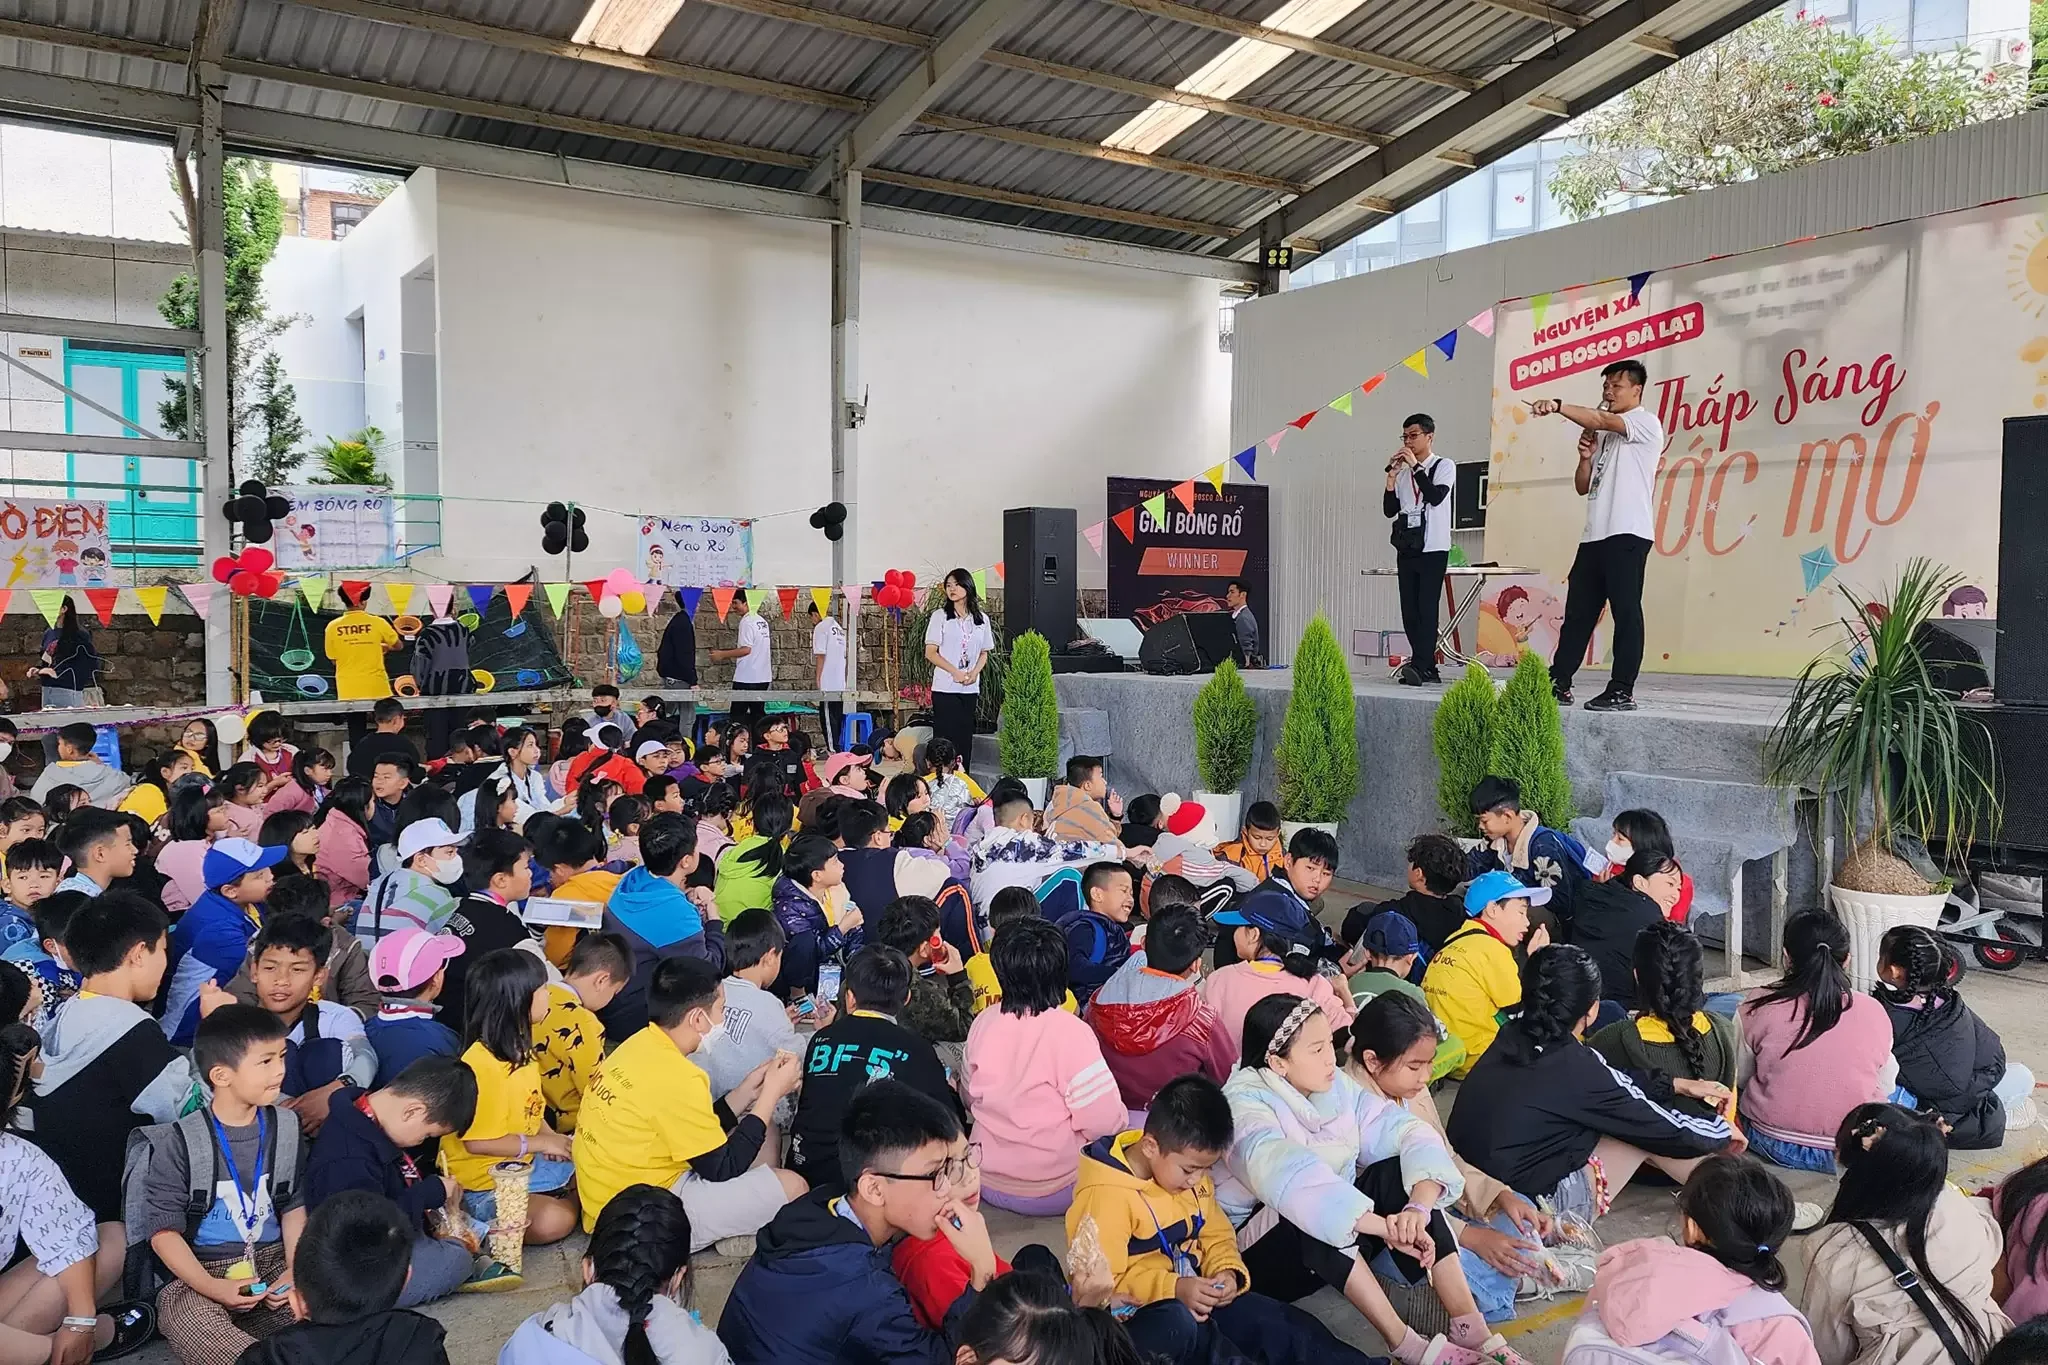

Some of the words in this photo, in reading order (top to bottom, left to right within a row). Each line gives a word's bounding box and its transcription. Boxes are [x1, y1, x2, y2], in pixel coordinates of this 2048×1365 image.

[1533, 304, 1609, 346] NGUYỆN
[1516, 357, 1557, 382] DON
[1560, 334, 1623, 369] BOSCO
[1625, 323, 1655, 348] ĐÀ
[1659, 312, 1696, 341] LẠT
[1774, 349, 1907, 427] Sáng
[288, 497, 309, 512] ÉM
[1221, 505, 1245, 537] RỔ
[1166, 552, 1219, 570] WINNER
[337, 624, 372, 636] STAFF
[808, 1044, 860, 1074] BF
